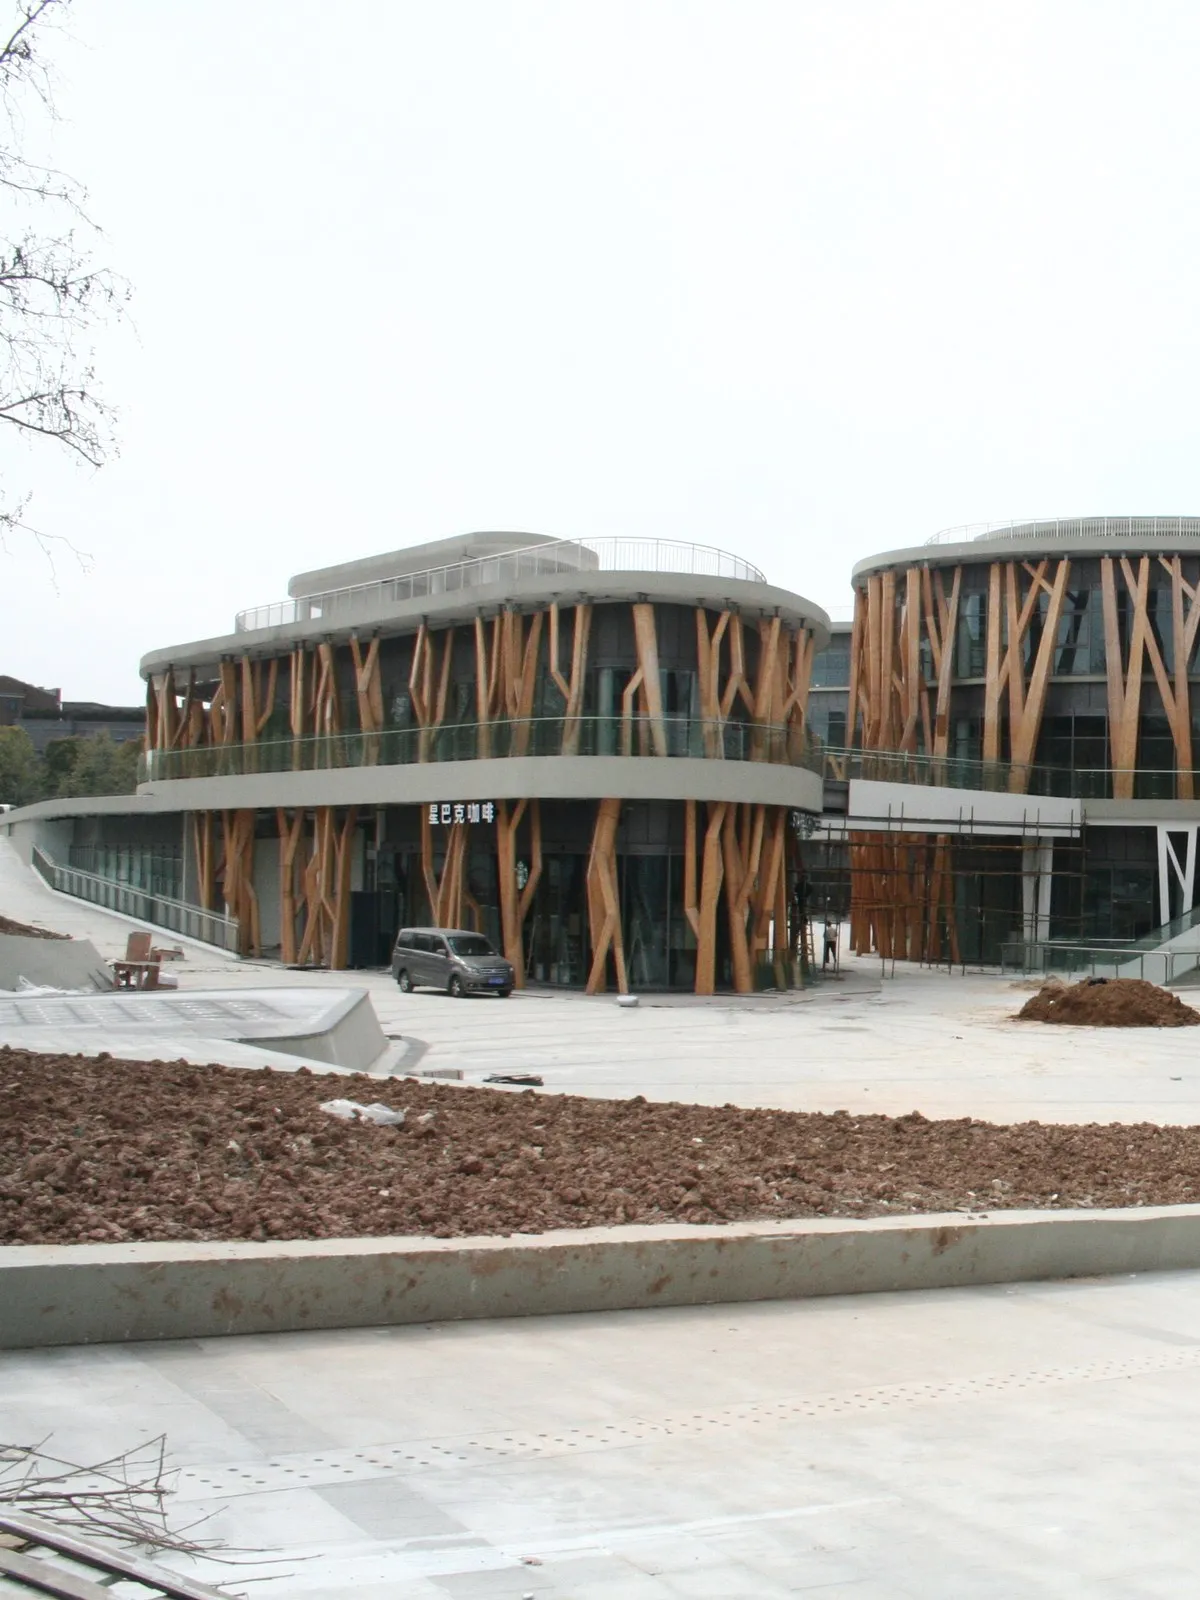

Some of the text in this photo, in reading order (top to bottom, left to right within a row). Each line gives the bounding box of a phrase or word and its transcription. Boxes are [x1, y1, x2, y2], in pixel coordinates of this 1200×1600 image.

[428, 802, 495, 825] 星巴克咖啡
